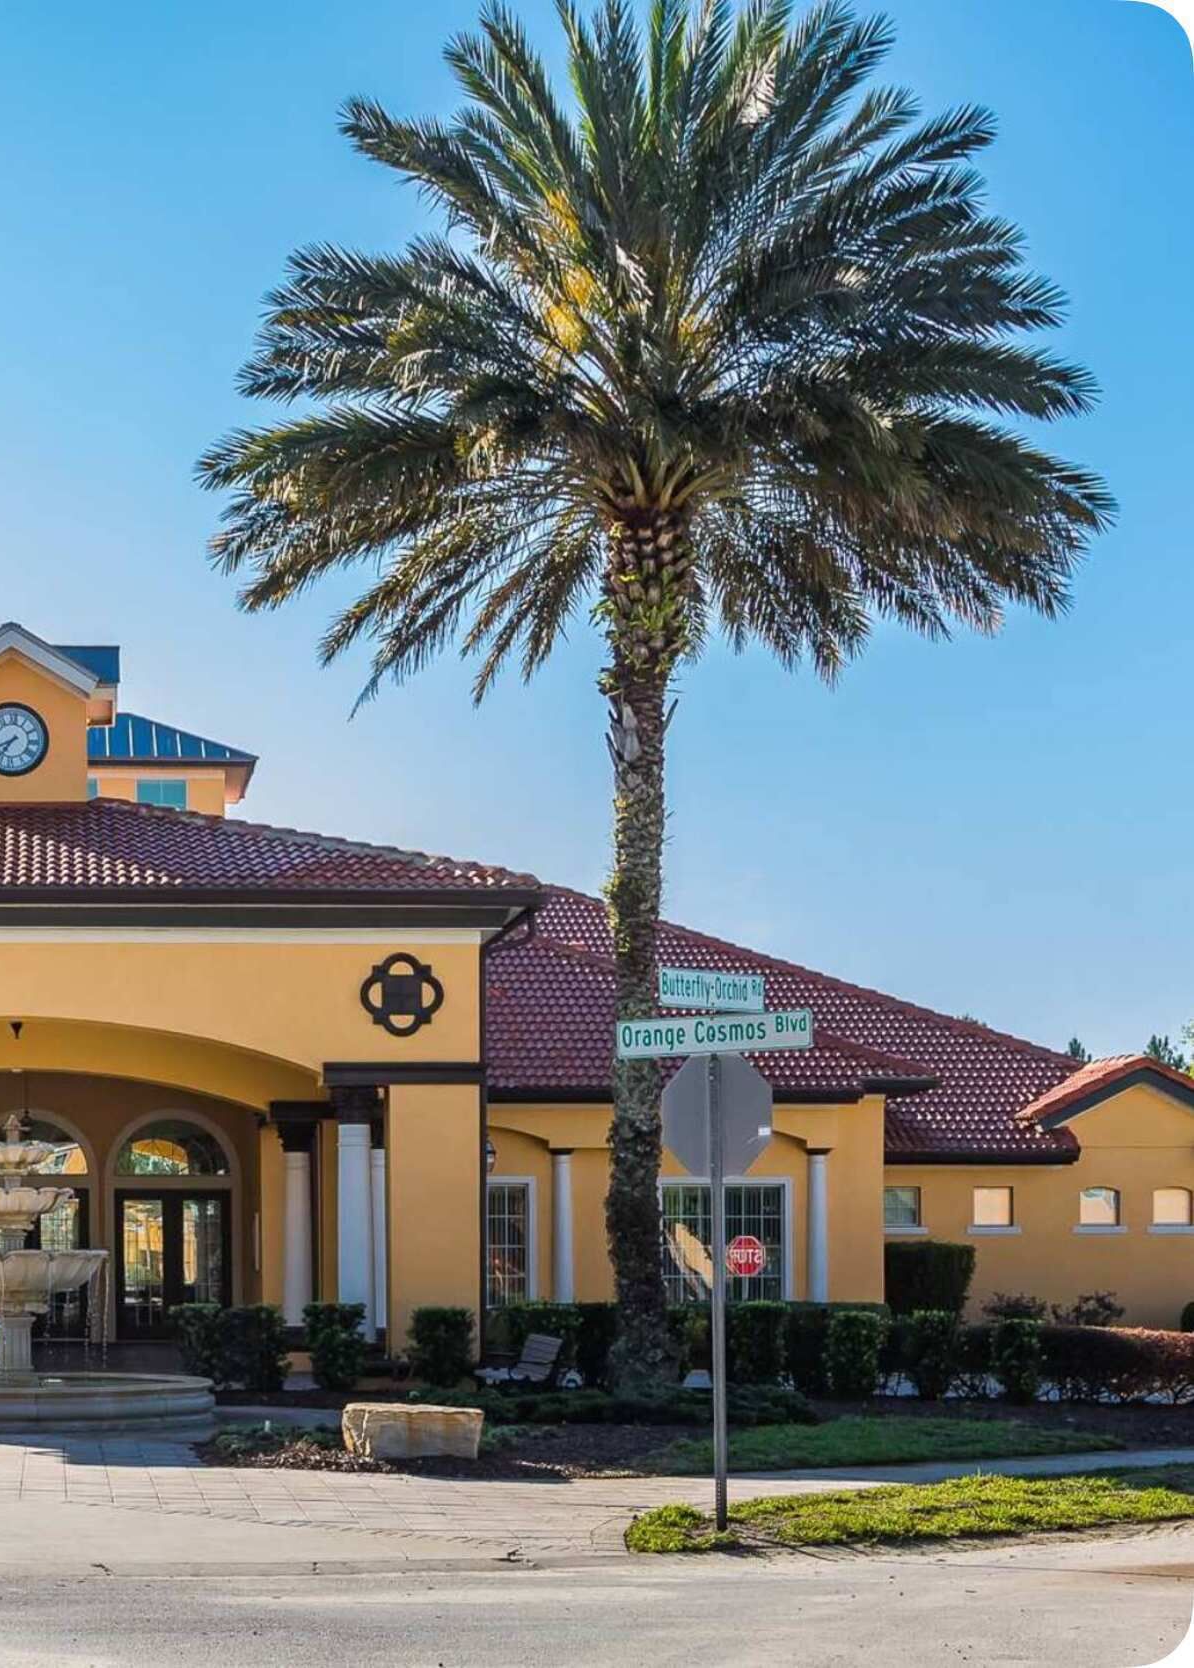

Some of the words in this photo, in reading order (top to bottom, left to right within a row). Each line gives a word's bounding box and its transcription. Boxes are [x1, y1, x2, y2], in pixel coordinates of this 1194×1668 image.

[751, 979, 762, 997] Rd
[622, 1025, 686, 1050] Orange
[694, 1020, 766, 1043] Cosmos
[775, 1015, 807, 1034] Blvd
